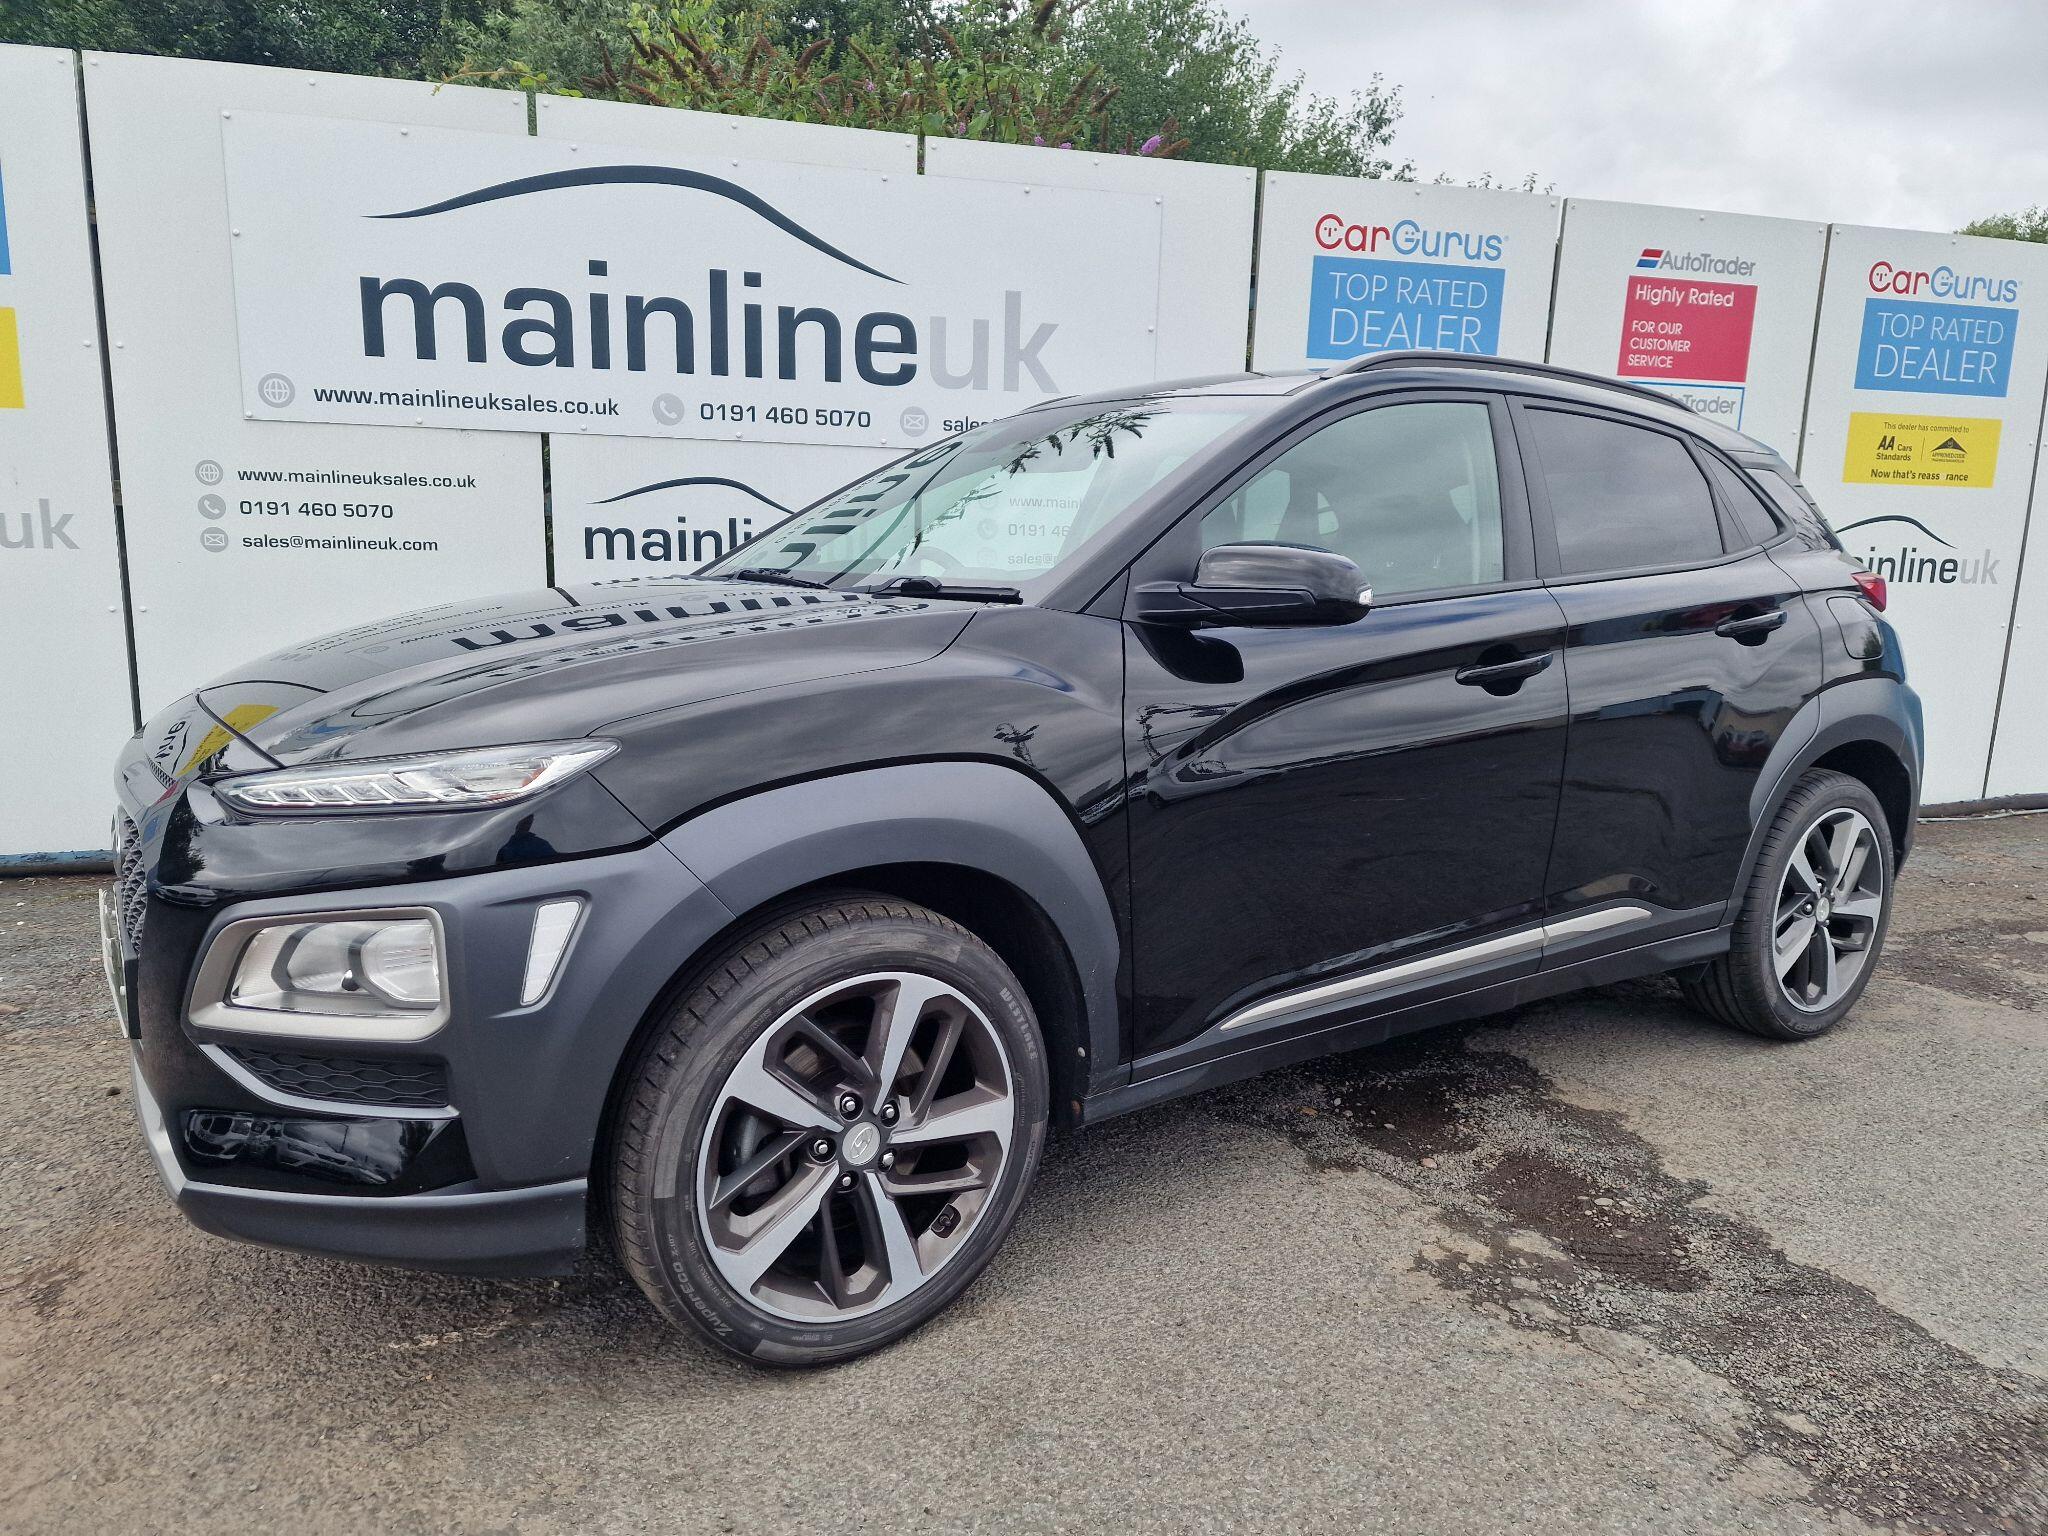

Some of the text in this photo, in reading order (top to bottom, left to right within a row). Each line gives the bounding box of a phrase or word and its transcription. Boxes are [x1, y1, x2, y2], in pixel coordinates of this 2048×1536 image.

[1315, 213, 1503, 262] CarGurus
[1659, 250, 1756, 277] AutoTrader
[1329, 271, 1488, 309] TOP RATED
[1868, 261, 2018, 303] CarGurus
[1636, 284, 1735, 307] Highly Rated
[359, 260, 1060, 394] mainlineuk
[1329, 307, 1483, 353] DEALER
[1632, 320, 1683, 335] FOR OUR
[1877, 312, 2004, 345] TOP RATED
[1630, 337, 1691, 352] CUSTOMER
[1628, 354, 1674, 368] SERVICE
[1873, 344, 1997, 384] DEALER
[313, 387, 619, 416] www.mainlineuksales.co.uk
[1682, 394, 1737, 414] Trader
[700, 402, 871, 428] 0191 460 5070
[1884, 421, 1896, 430] This
[1898, 423, 1917, 431] dealer
[1918, 423, 1929, 431] has
[1929, 424, 1962, 433] committed
[1877, 435, 1912, 452] AA Cars
[1876, 452, 1911, 461] Standards
[237, 469, 476, 488] www.mainlineuksales.co.uk
[1871, 469, 1890, 479] Now
[239, 500, 393, 518] 0191 460 5070
[1008, 523, 1045, 537] 0191
[242, 534, 438, 551] sales@mainlineuk.com
[1853, 546, 2000, 584] inlineuk
